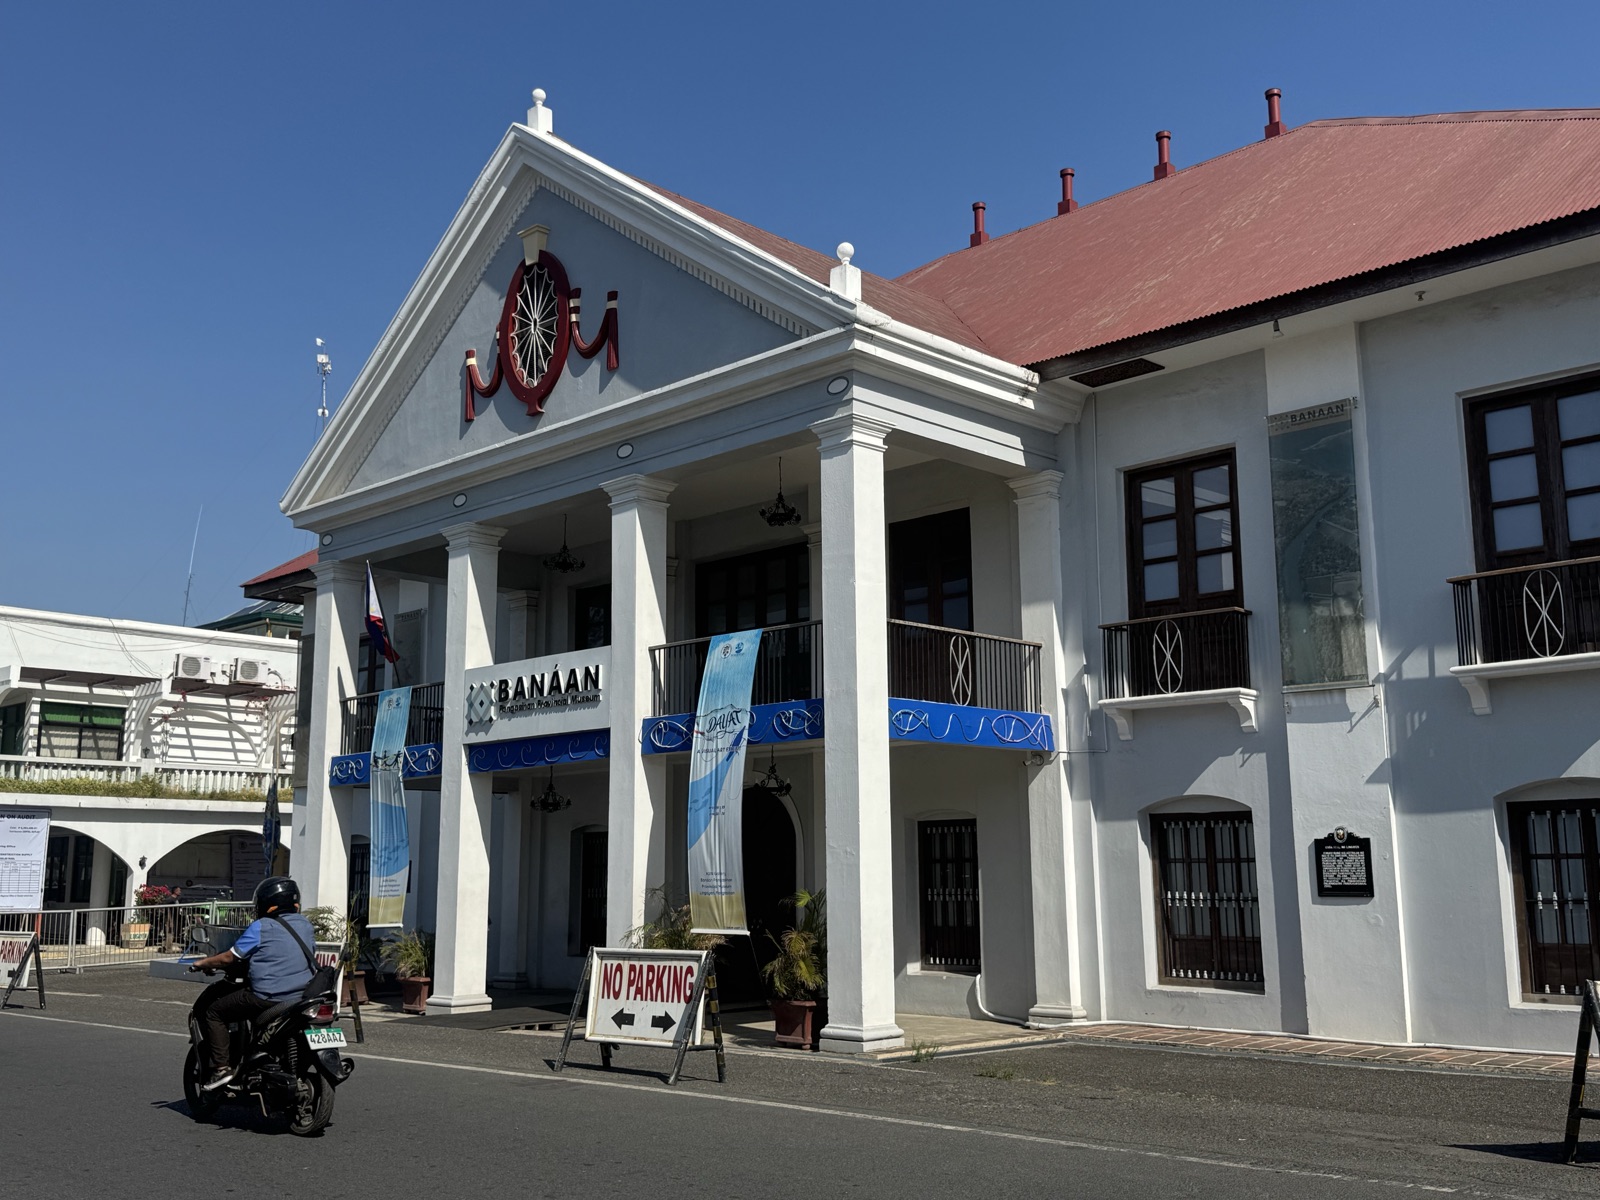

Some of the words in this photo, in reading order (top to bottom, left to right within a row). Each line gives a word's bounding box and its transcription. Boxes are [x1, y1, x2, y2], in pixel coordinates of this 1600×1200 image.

[499, 664, 602, 702] BANÁAN
[499, 702, 535, 714] Pangasinan
[538, 697, 569, 709] Provincial
[571, 694, 601, 705] Museum
[601, 963, 623, 1000] NO
[626, 964, 694, 1004] PARKING
[310, 1032, 344, 1044] 428AAZ
